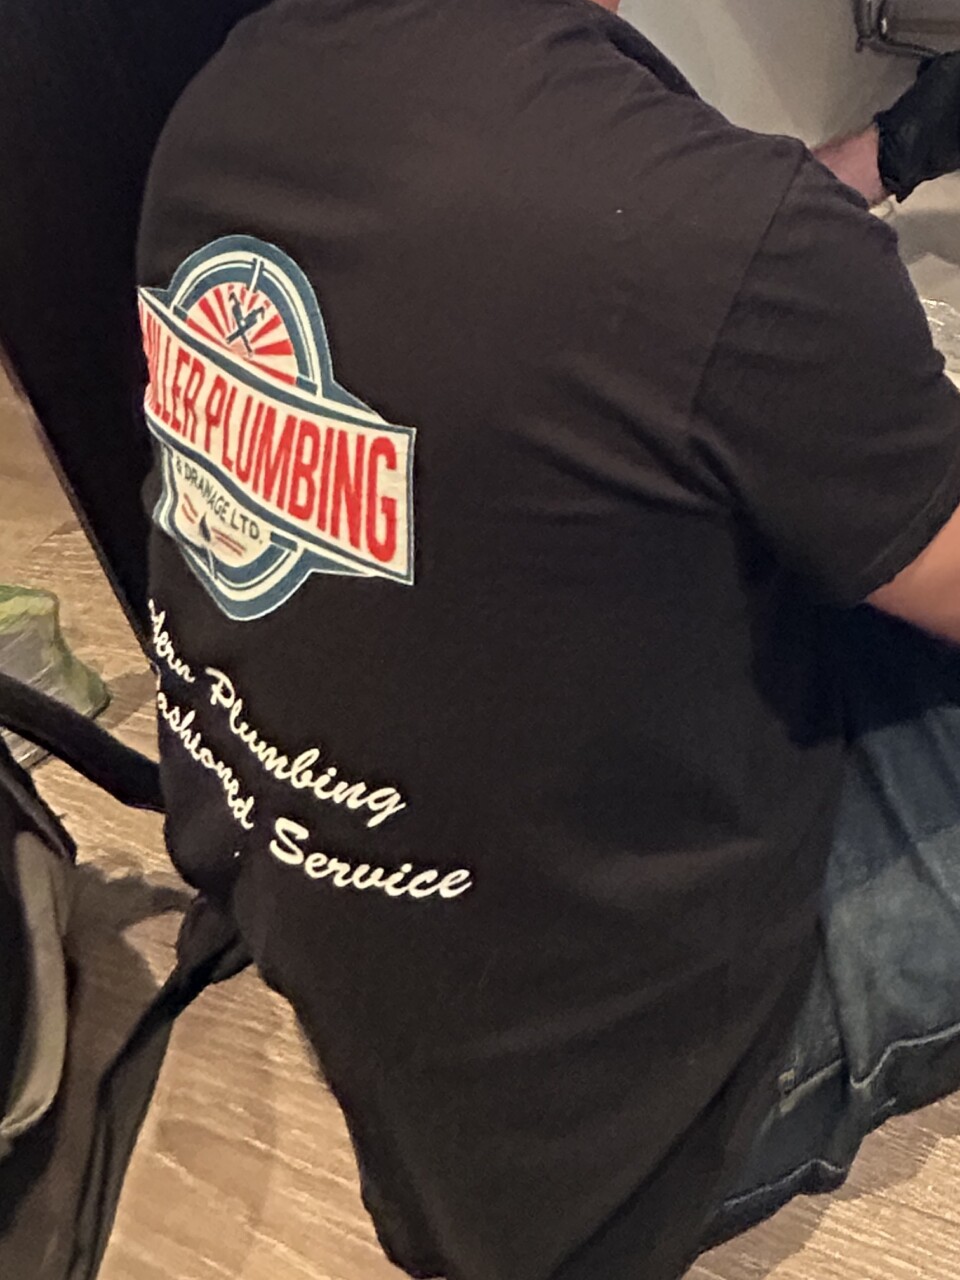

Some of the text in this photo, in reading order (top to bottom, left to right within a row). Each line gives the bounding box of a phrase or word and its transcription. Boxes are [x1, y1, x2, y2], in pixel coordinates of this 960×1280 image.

[204, 375, 397, 563] PLUMBING
[230, 508, 264, 545] LTD.
[205, 667, 406, 828] Plumbing
[269, 817, 472, 899] Service
